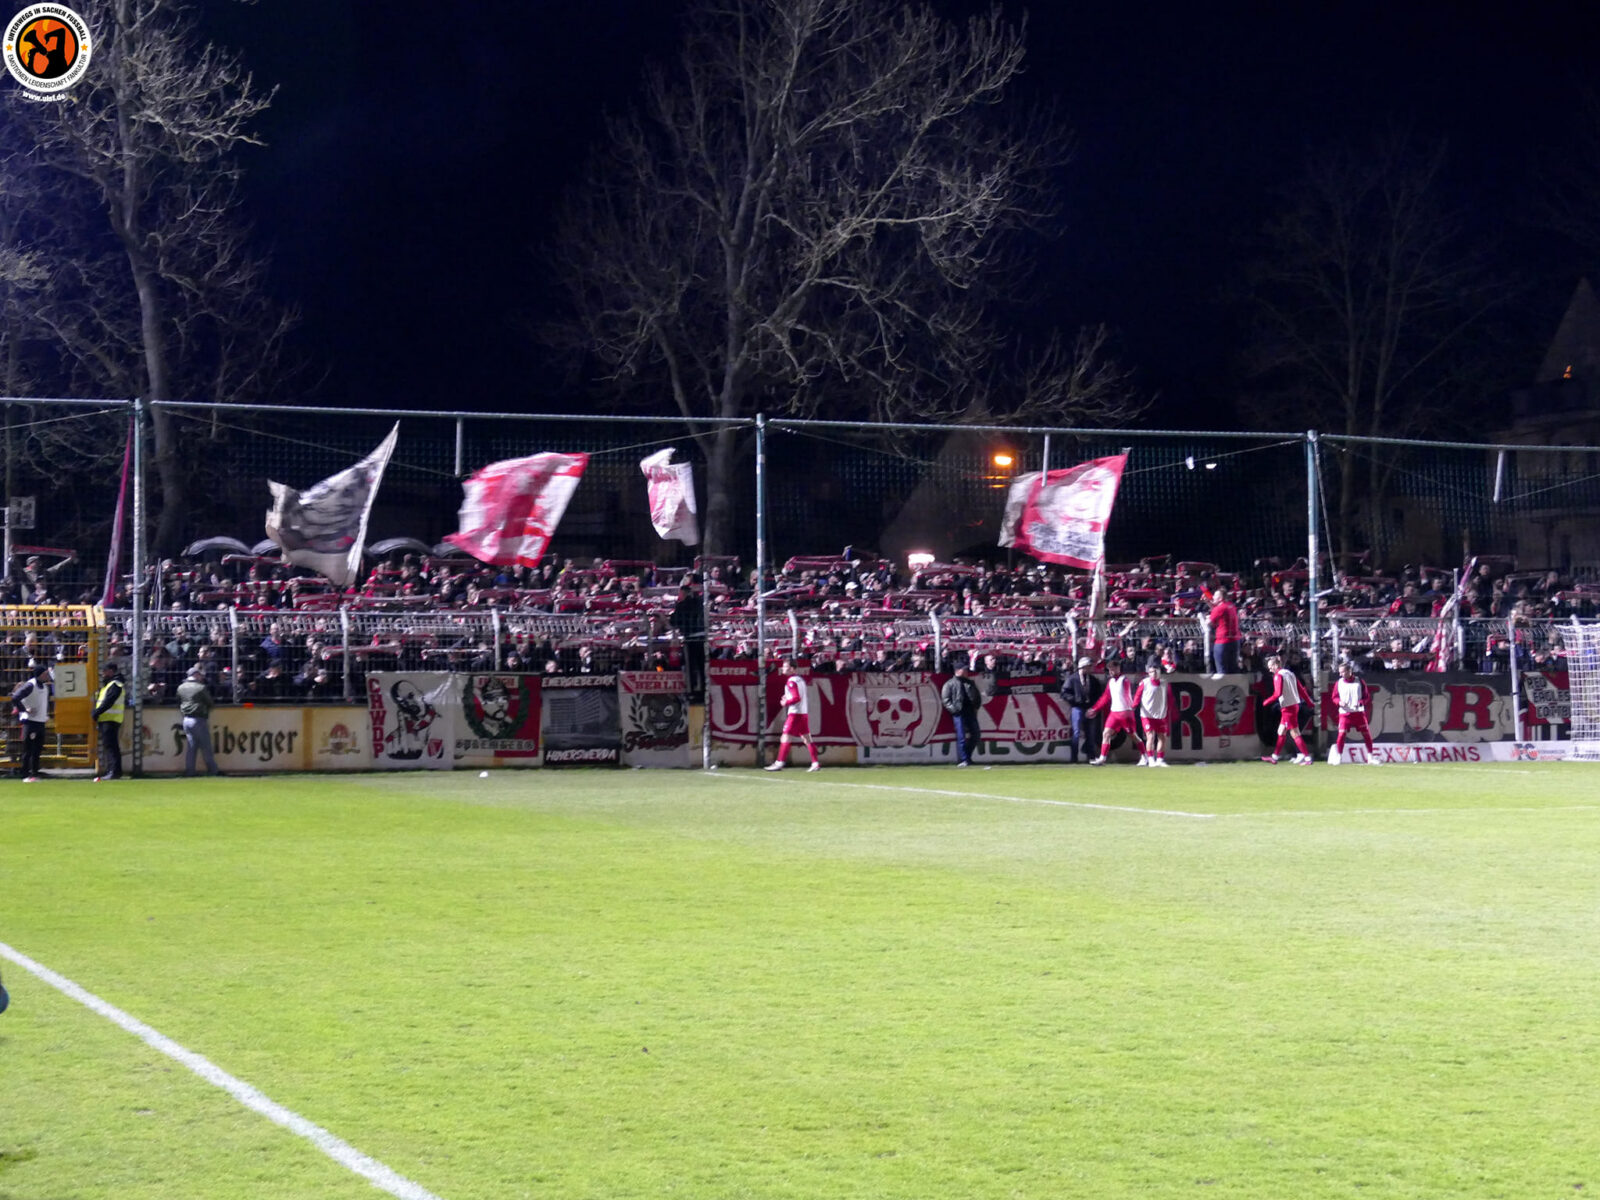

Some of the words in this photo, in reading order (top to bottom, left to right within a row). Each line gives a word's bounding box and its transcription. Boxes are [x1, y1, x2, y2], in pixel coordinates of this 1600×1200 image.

[709, 667, 747, 675] ELSTER
[65, 671, 76, 692] 3
[1536, 705, 1572, 719] COTTB
[170, 721, 298, 762] Fiberger
[545, 749, 617, 761] HOYERSWERDA
